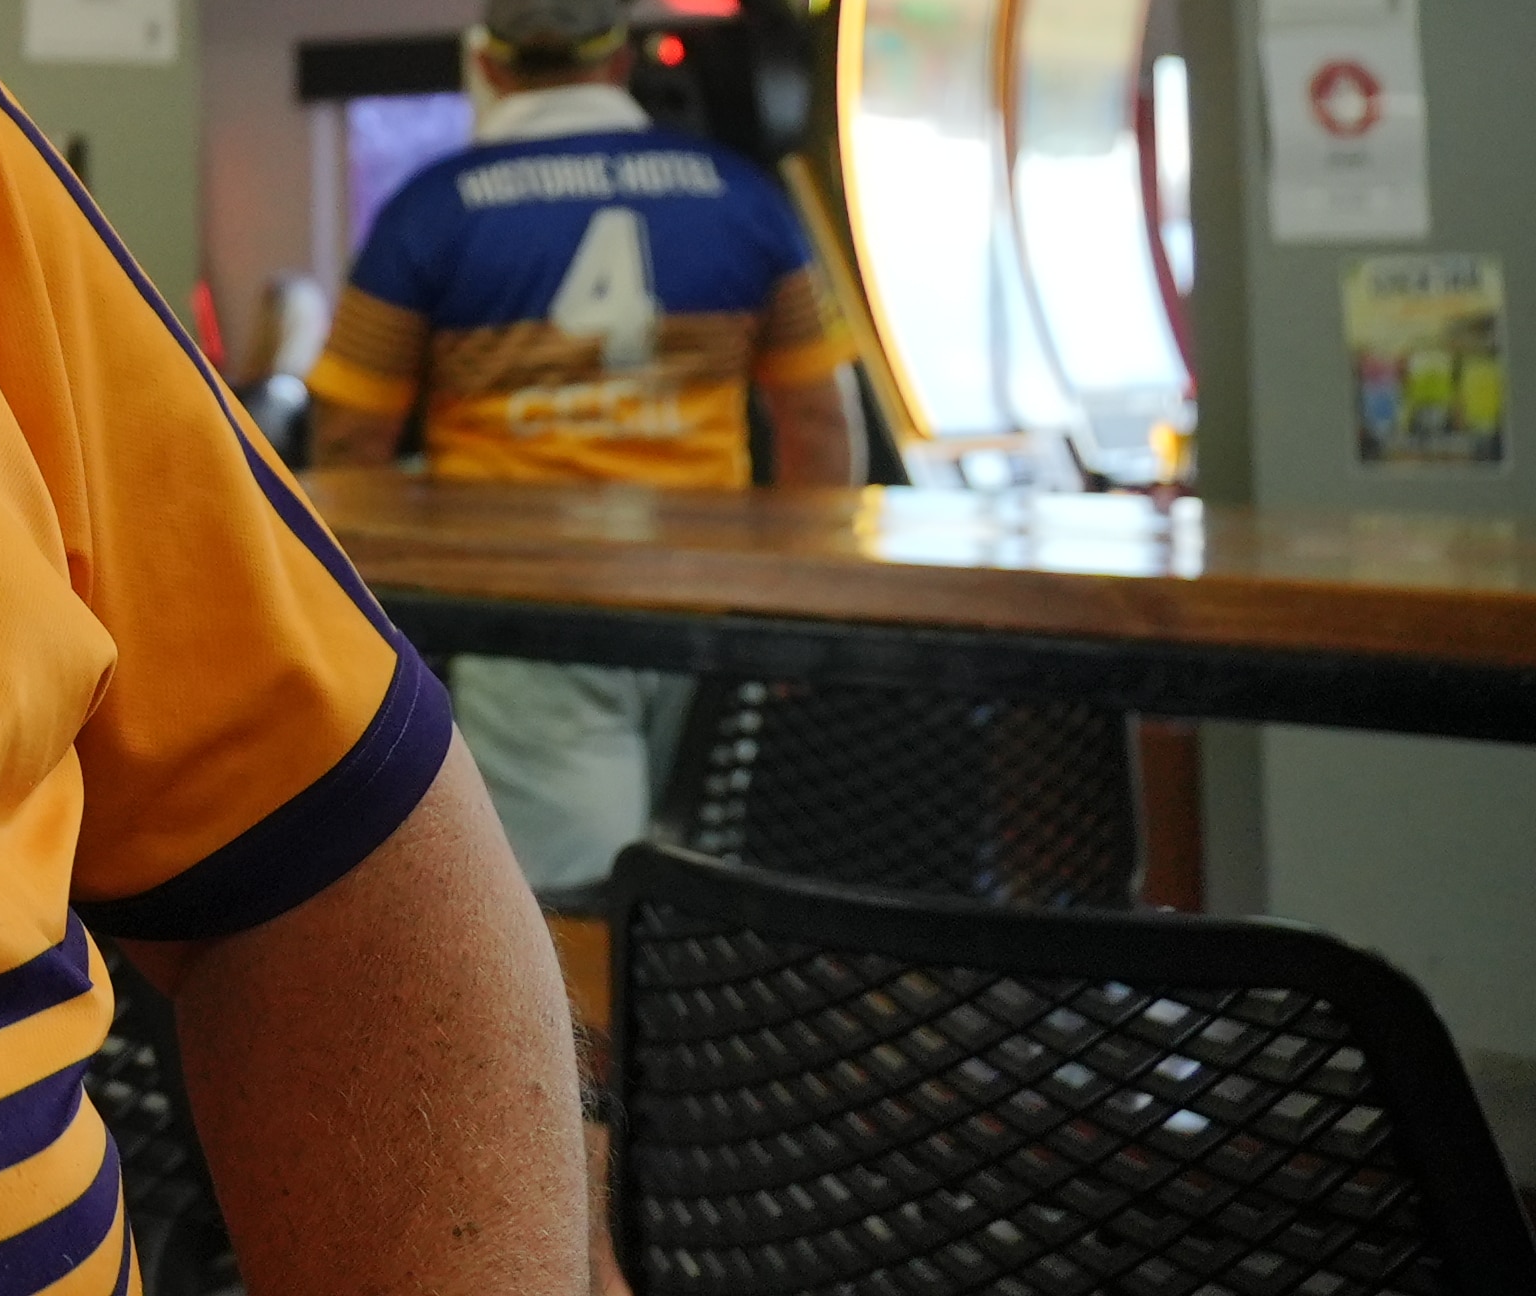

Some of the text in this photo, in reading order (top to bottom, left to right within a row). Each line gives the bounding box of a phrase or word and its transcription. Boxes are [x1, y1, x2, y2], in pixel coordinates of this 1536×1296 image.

[457, 150, 726, 210] HISTORIC HOTEL
[550, 206, 660, 372] 4
